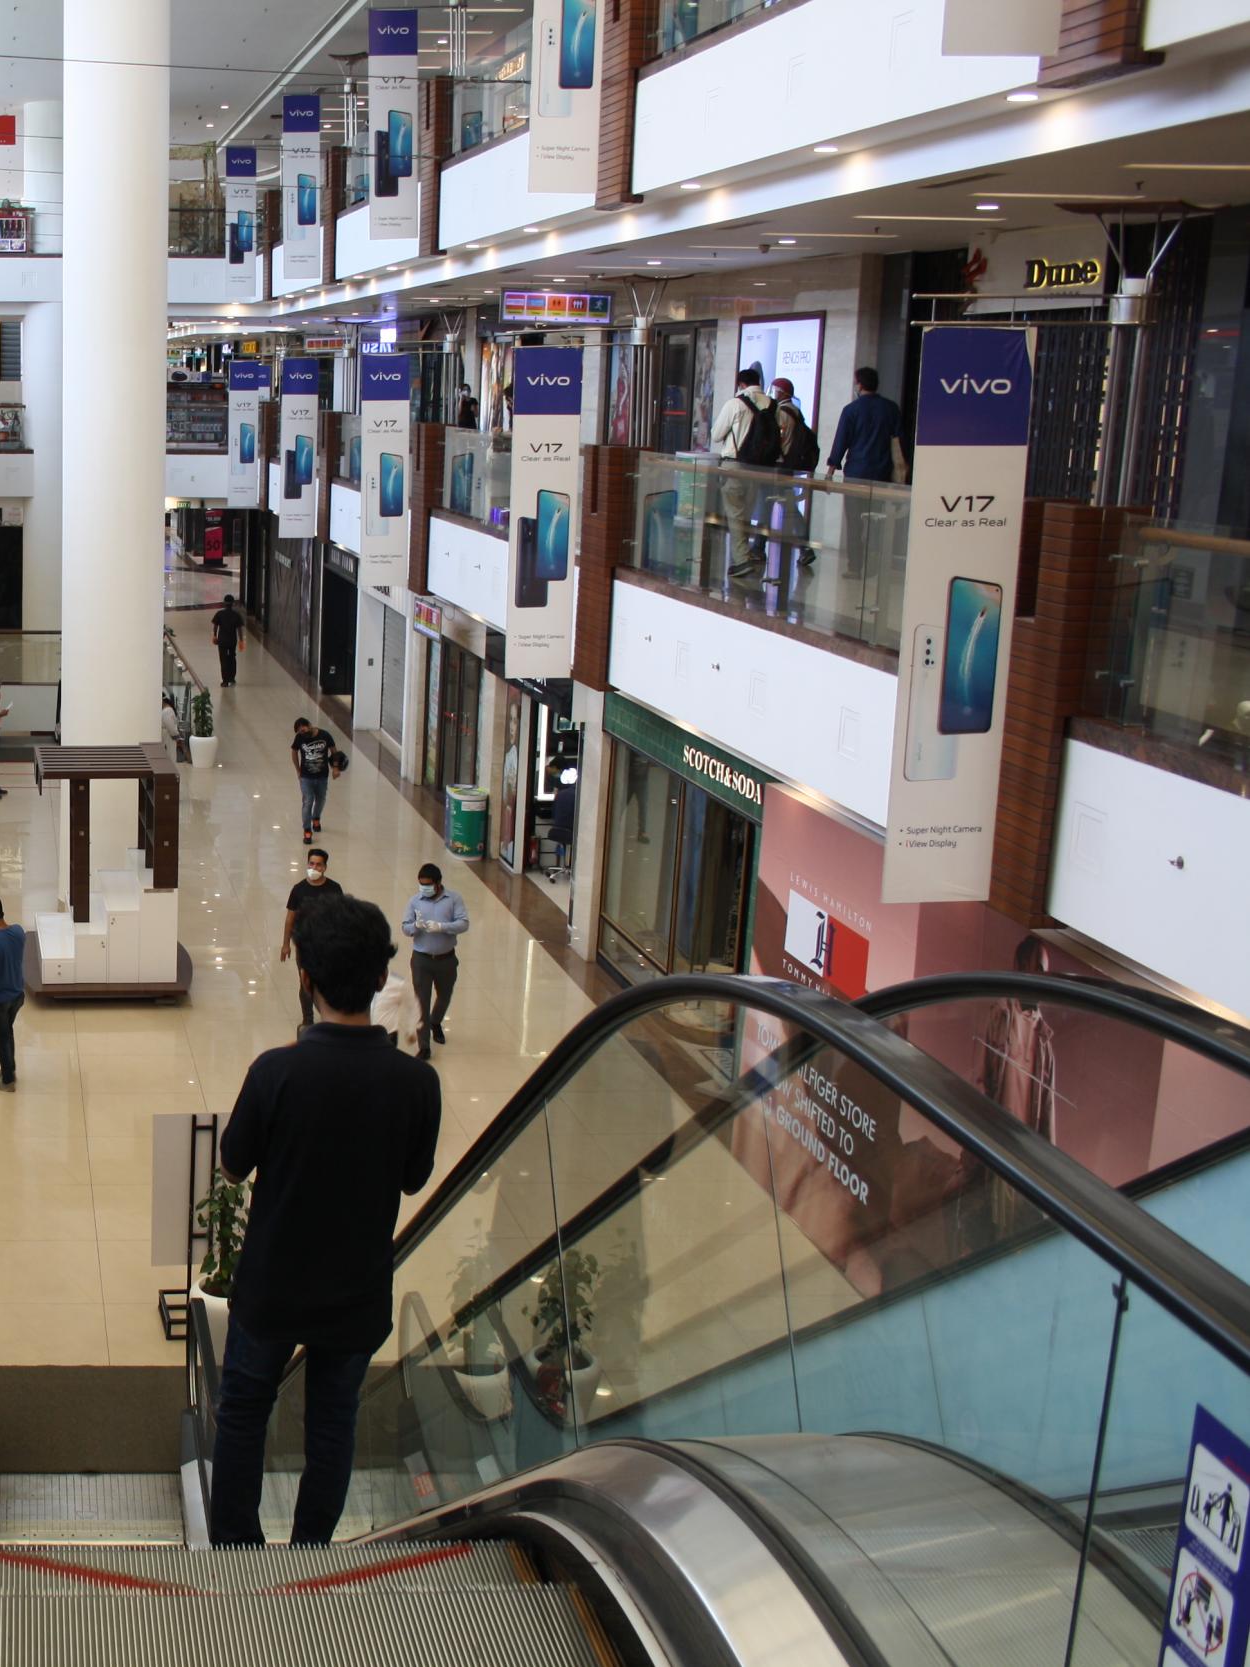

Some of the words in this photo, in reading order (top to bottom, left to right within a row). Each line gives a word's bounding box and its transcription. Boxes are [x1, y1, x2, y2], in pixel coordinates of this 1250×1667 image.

[377, 25, 409, 35] vivo
[382, 75, 406, 84] V17
[289, 109, 314, 117] vivo
[1024, 257, 1100, 290] Dune
[370, 371, 402, 381] vivo
[526, 373, 570, 386] vivo
[940, 373, 1012, 395] vivo
[530, 443, 563, 453] V17
[941, 496, 995, 513] V17
[925, 517, 958, 528] Clear
[961, 519, 975, 527] as
[978, 517, 1007, 527] Real
[683, 744, 762, 805] SCOTCH&SODA
[906, 826, 929, 835] Super
[930, 826, 951, 835] Night
[953, 825, 982, 833] Camera
[929, 840, 957, 848] Display
[790, 871, 818, 897] LEWIS
[823, 893, 871, 932] HAMILTON
[782, 958, 812, 989] TOMMY
[794, 1088, 836, 1139] SHIFTED
[839, 1126, 854, 1156] TO
[840, 1095, 877, 1142] STORE
[776, 1105, 826, 1163] GROUND
[828, 1152, 869, 1206] FLOOR
